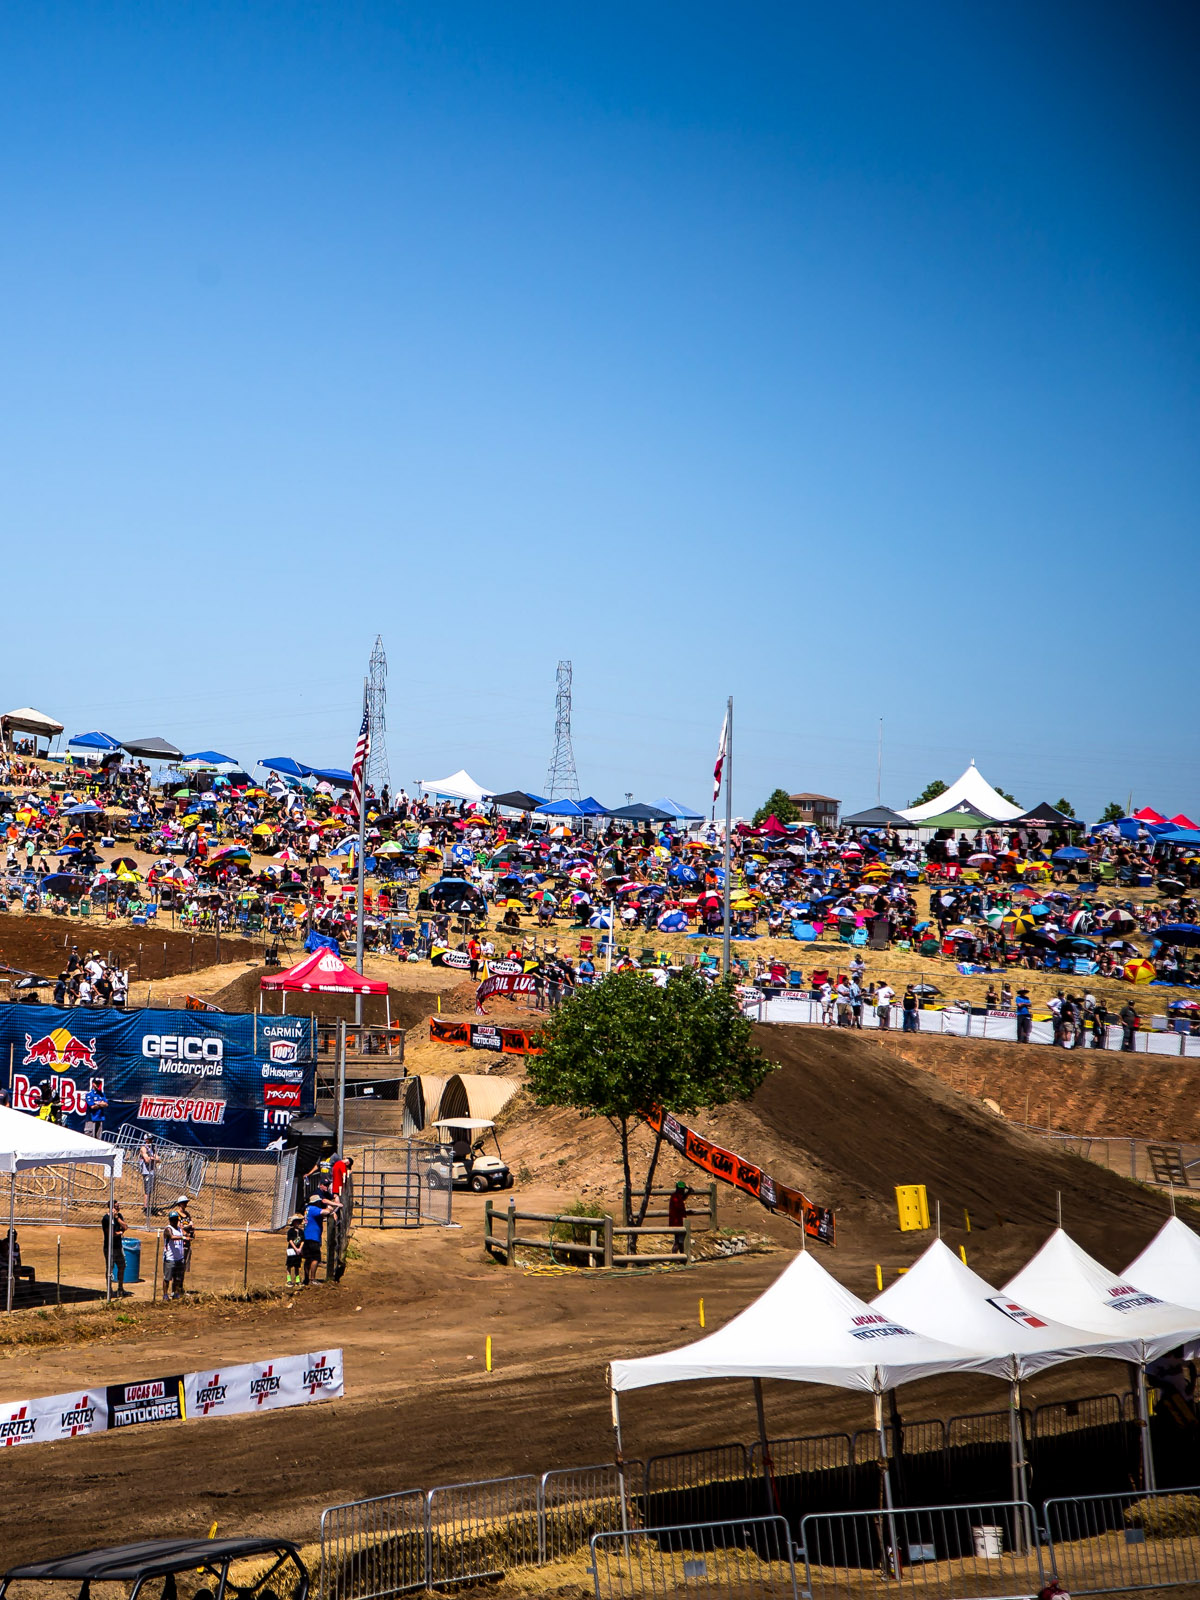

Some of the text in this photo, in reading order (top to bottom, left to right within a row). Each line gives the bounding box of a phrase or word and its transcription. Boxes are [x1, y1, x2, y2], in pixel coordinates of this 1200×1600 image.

[263, 1026, 304, 1037] GARMIN
[142, 1034, 223, 1060] GEICO
[273, 1046, 294, 1059] 100%
[158, 1058, 223, 1078] Motorcycle
[269, 1067, 303, 1079] Husqvarna
[711, 1152, 733, 1175] KTM
[851, 1315, 876, 1326] LUCAS
[250, 1376, 281, 1394] VERTEX
[303, 1366, 335, 1385] VERTEX
[127, 1383, 163, 1401] LUCAS OIL
[196, 1385, 228, 1404] VERTEX
[61, 1407, 96, 1427] VERTEX
[114, 1402, 178, 1426] MOTOCROSS
